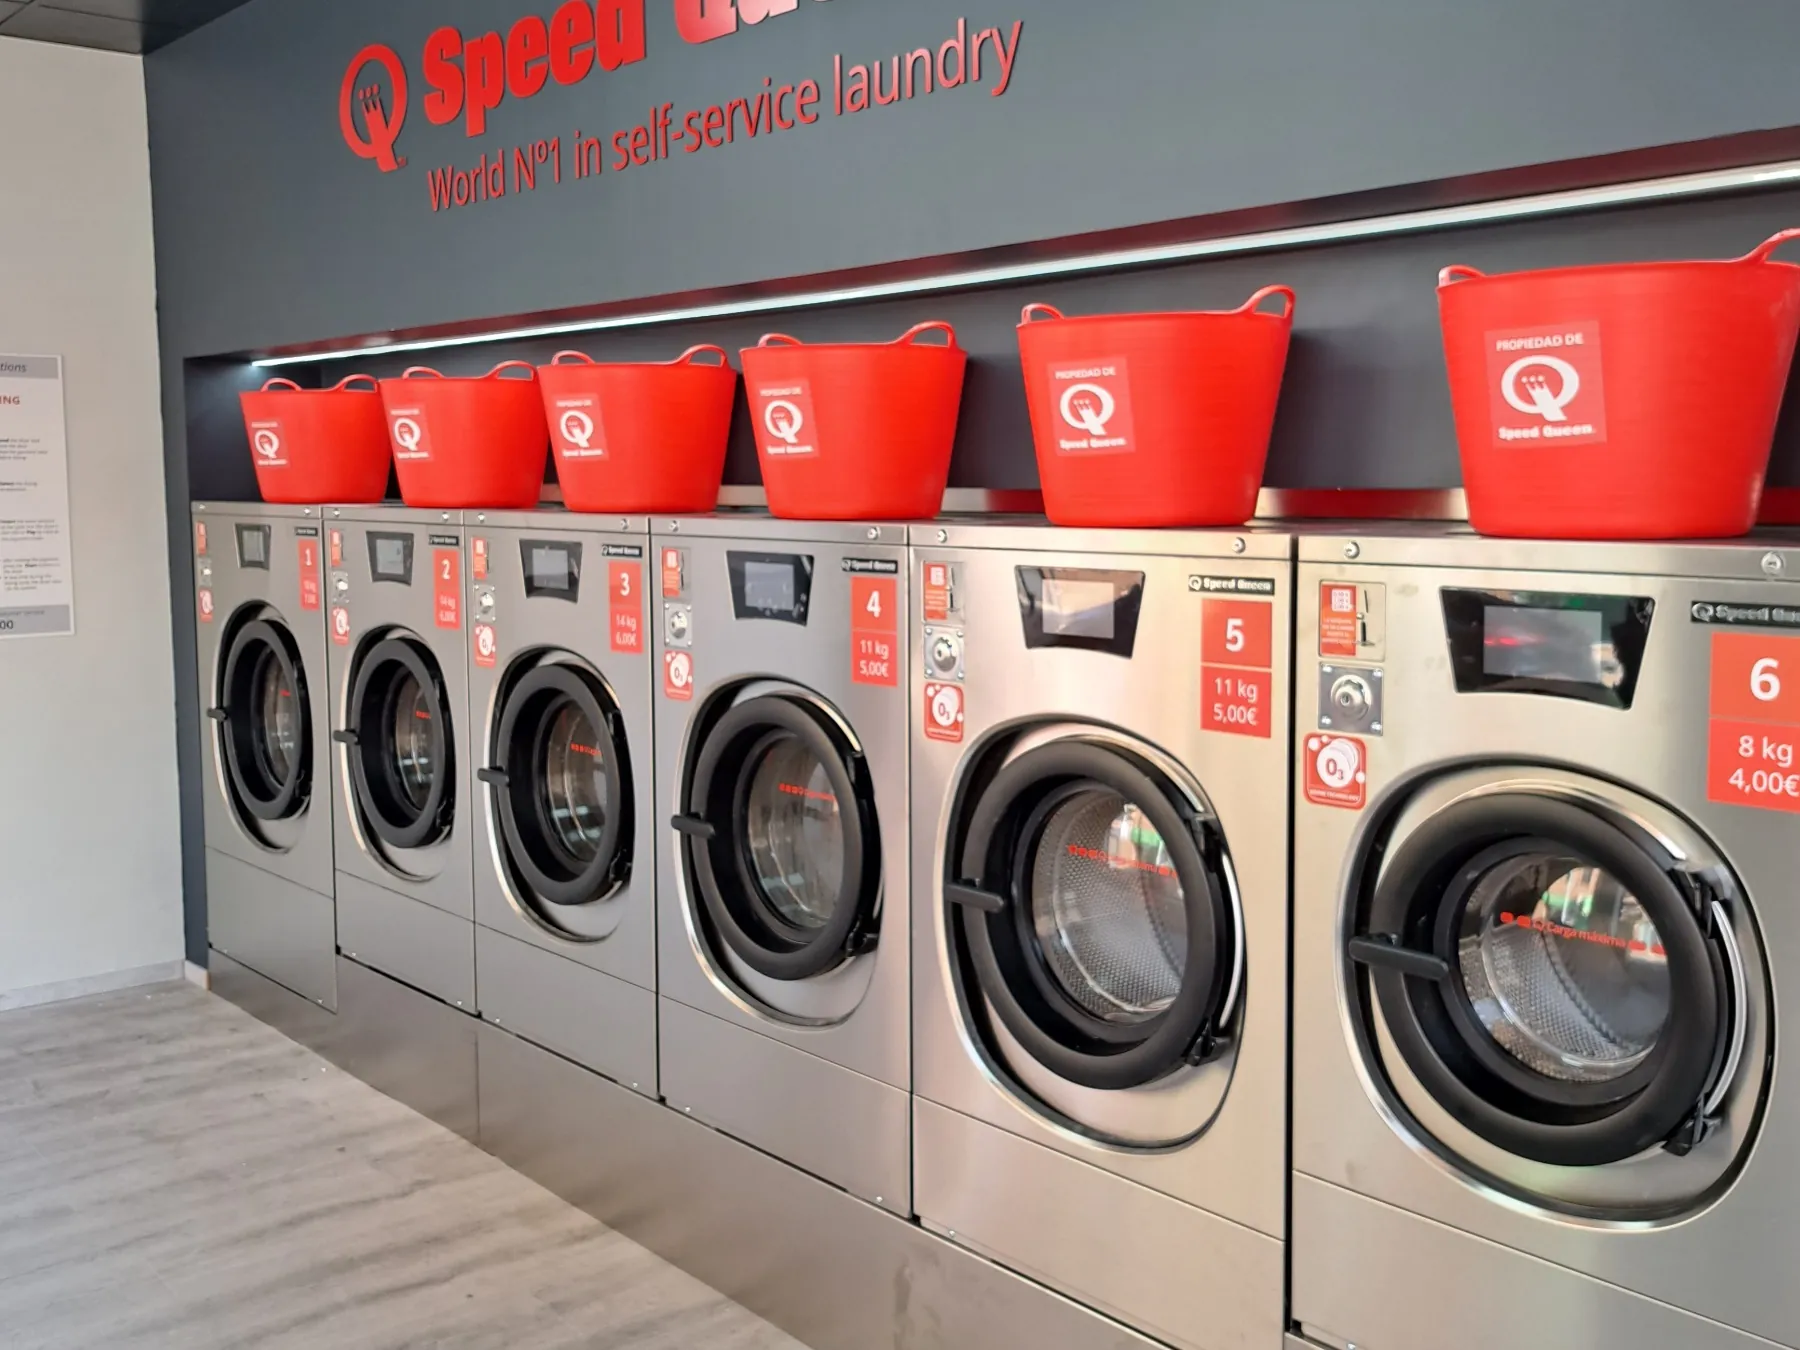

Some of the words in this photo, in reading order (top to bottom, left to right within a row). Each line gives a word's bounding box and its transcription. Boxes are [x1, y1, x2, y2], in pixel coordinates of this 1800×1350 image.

[423, 0, 647, 138] Speed
[427, 145, 505, 212] World
[574, 130, 601, 180] in
[611, 76, 820, 171] self-service
[834, 17, 1023, 116] laundry
[1496, 335, 1563, 351] PROPIEDAD
[1565, 333, 1584, 345] DE
[1102, 367, 1116, 376] DE
[1498, 426, 1539, 440] Speed
[1542, 424, 1593, 437] Queen
[305, 548, 313, 567] 1
[441, 558, 451, 580] 2
[620, 572, 630, 596] 3
[1203, 578, 1235, 590] Speed
[1238, 579, 1271, 591] Queen
[866, 590, 881, 618] 4
[1716, 605, 1769, 622] Speed
[616, 614, 626, 627] 14
[627, 615, 637, 631] kg
[1225, 618, 1245, 652] 5
[860, 640, 873, 655] 11
[874, 641, 889, 660] kg
[860, 660, 889, 678] 5,00€
[1750, 657, 1781, 701] 6
[1215, 677, 1232, 696] 11
[1237, 679, 1258, 704] kg
[1213, 703, 1258, 726] 5,00€
[1738, 735, 1755, 758] 8
[1762, 736, 1793, 768] kg
[1728, 768, 1800, 797] 4,00€
[1547, 921, 1576, 939] Carga
